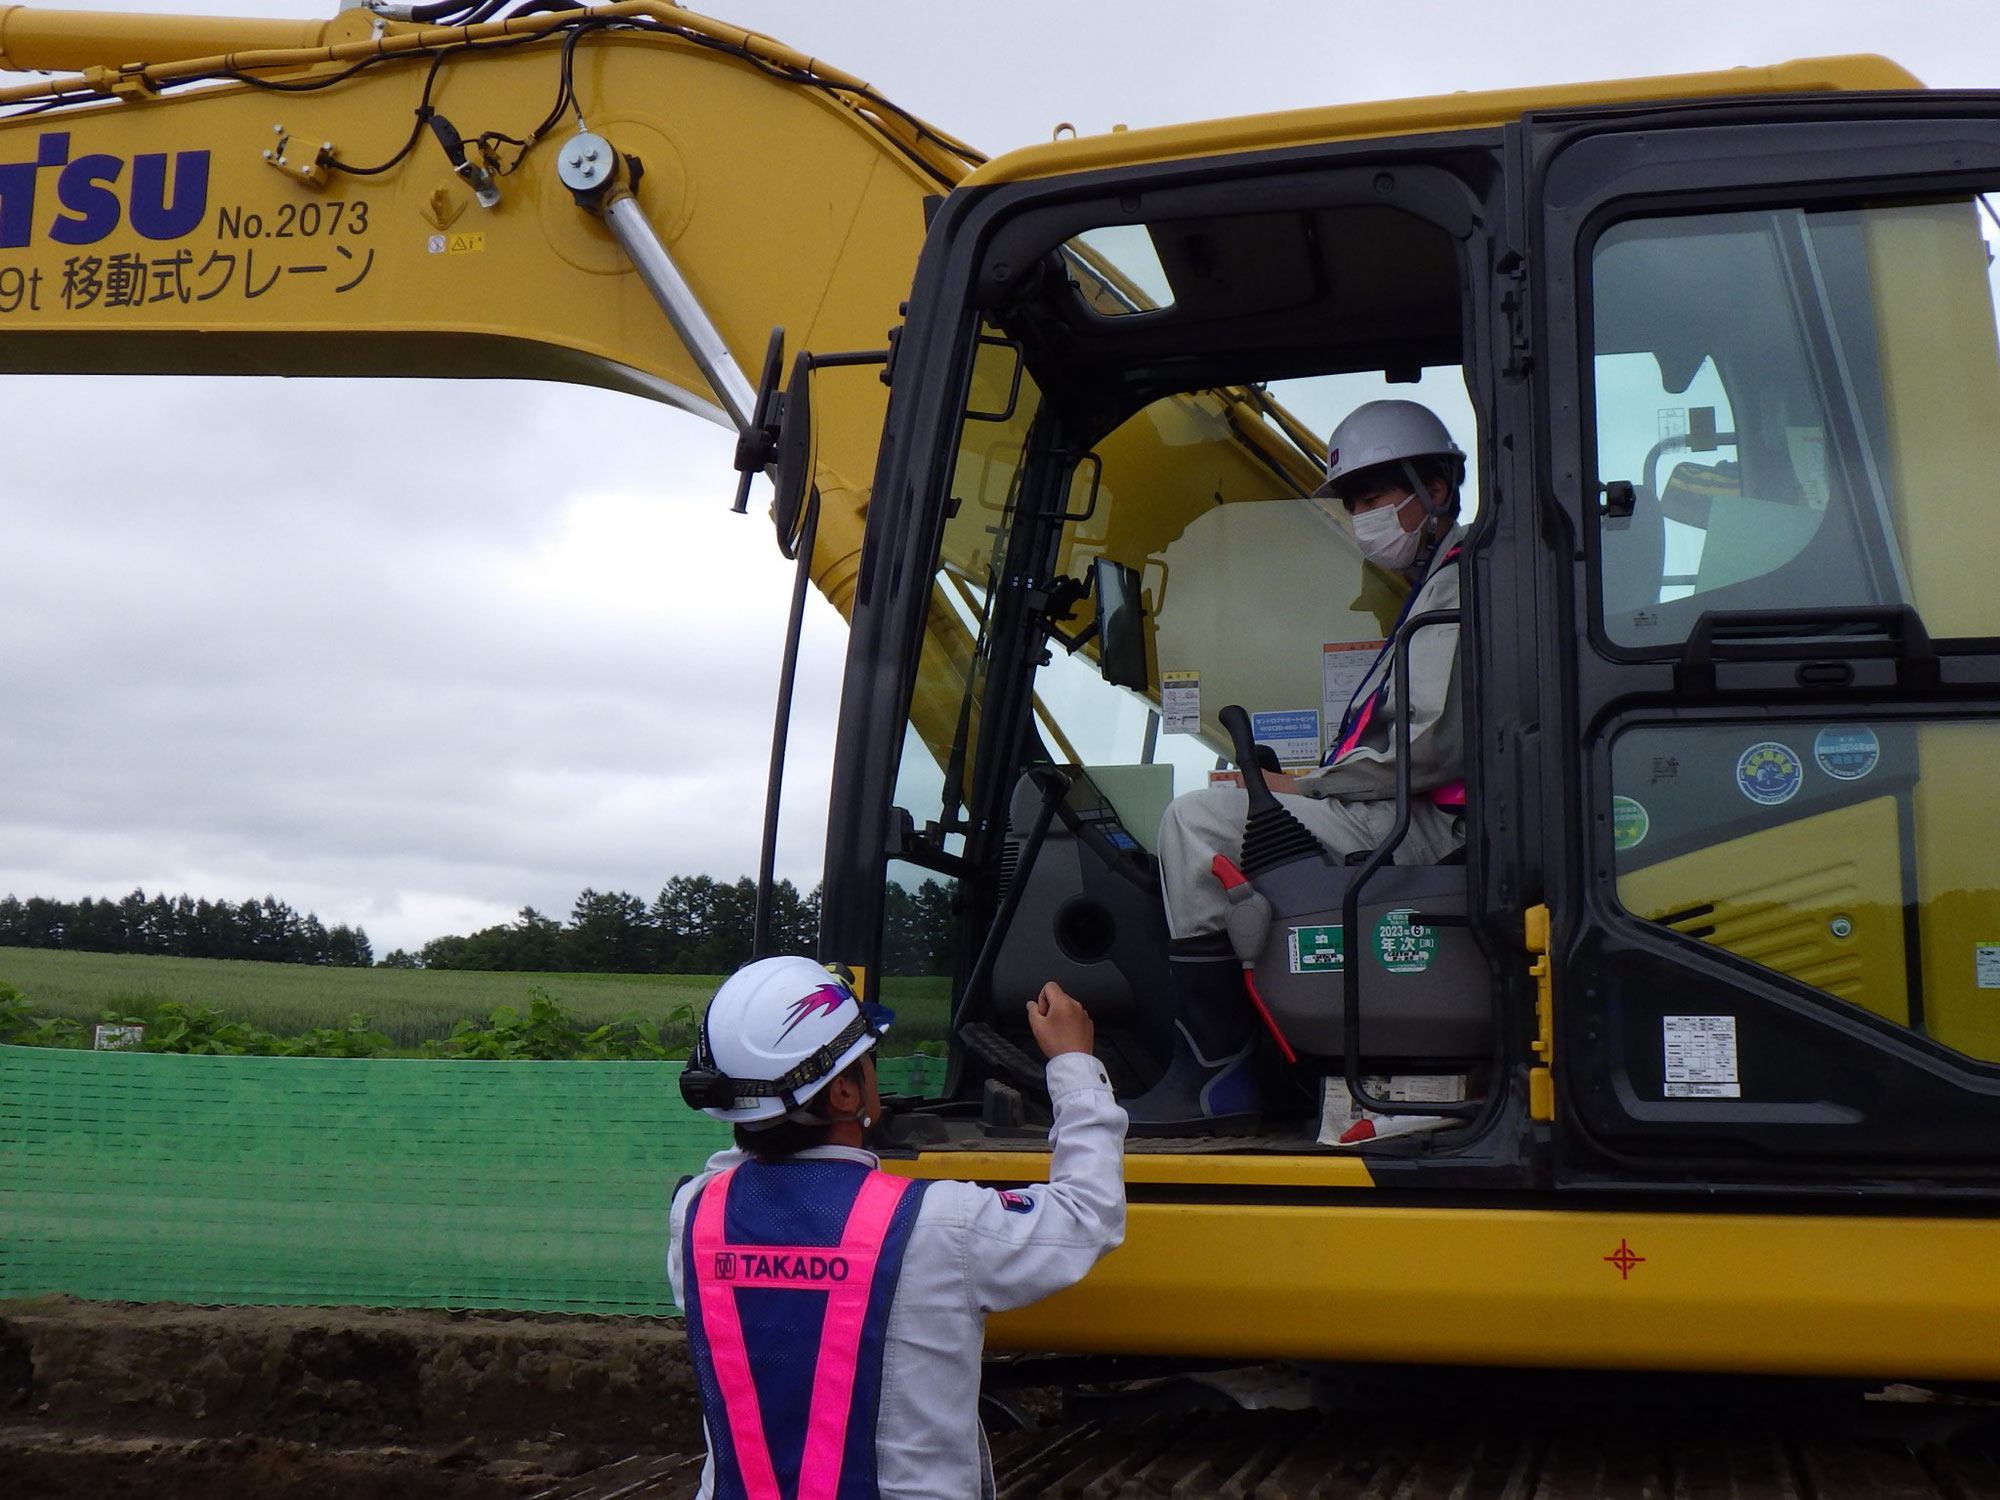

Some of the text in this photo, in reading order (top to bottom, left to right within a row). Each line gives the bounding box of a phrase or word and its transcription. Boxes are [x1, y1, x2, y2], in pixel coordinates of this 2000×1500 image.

[217, 201, 369, 240] No.2073
[0, 246, 374, 312] 9t 移動式クレーン
[741, 1254, 849, 1281] TAKADO
